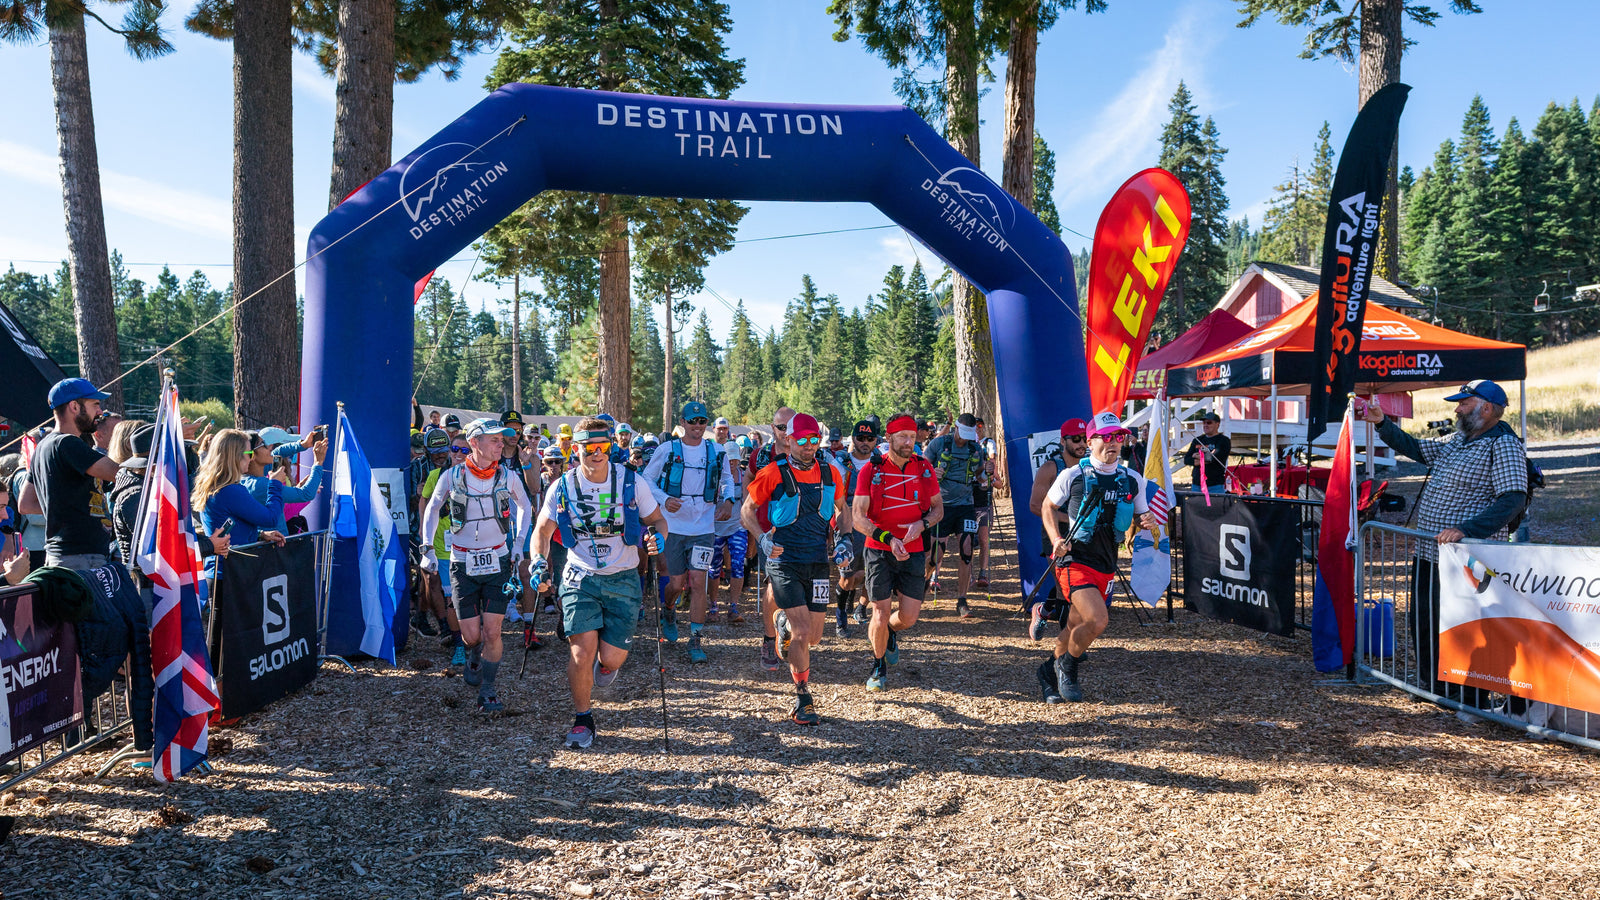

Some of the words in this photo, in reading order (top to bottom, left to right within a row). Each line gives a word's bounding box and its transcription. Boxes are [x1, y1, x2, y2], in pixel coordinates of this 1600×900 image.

[597, 103, 843, 135] DESTINATION
[674, 133, 772, 159] TRAIL
[409, 161, 509, 240] DESTINATION
[446, 195, 488, 227] TRAIL
[921, 178, 1009, 252] DESTINATION
[940, 208, 975, 240] TRAIL
[1347, 244, 1371, 322] adventure
[1361, 203, 1379, 239] light
[1094, 193, 1182, 388] LEKI
[1425, 368, 1441, 377] light
[859, 425, 873, 433] RA
[473, 553, 493, 567] 160
[1450, 667, 1533, 690] www.tailwindnutrition.com
